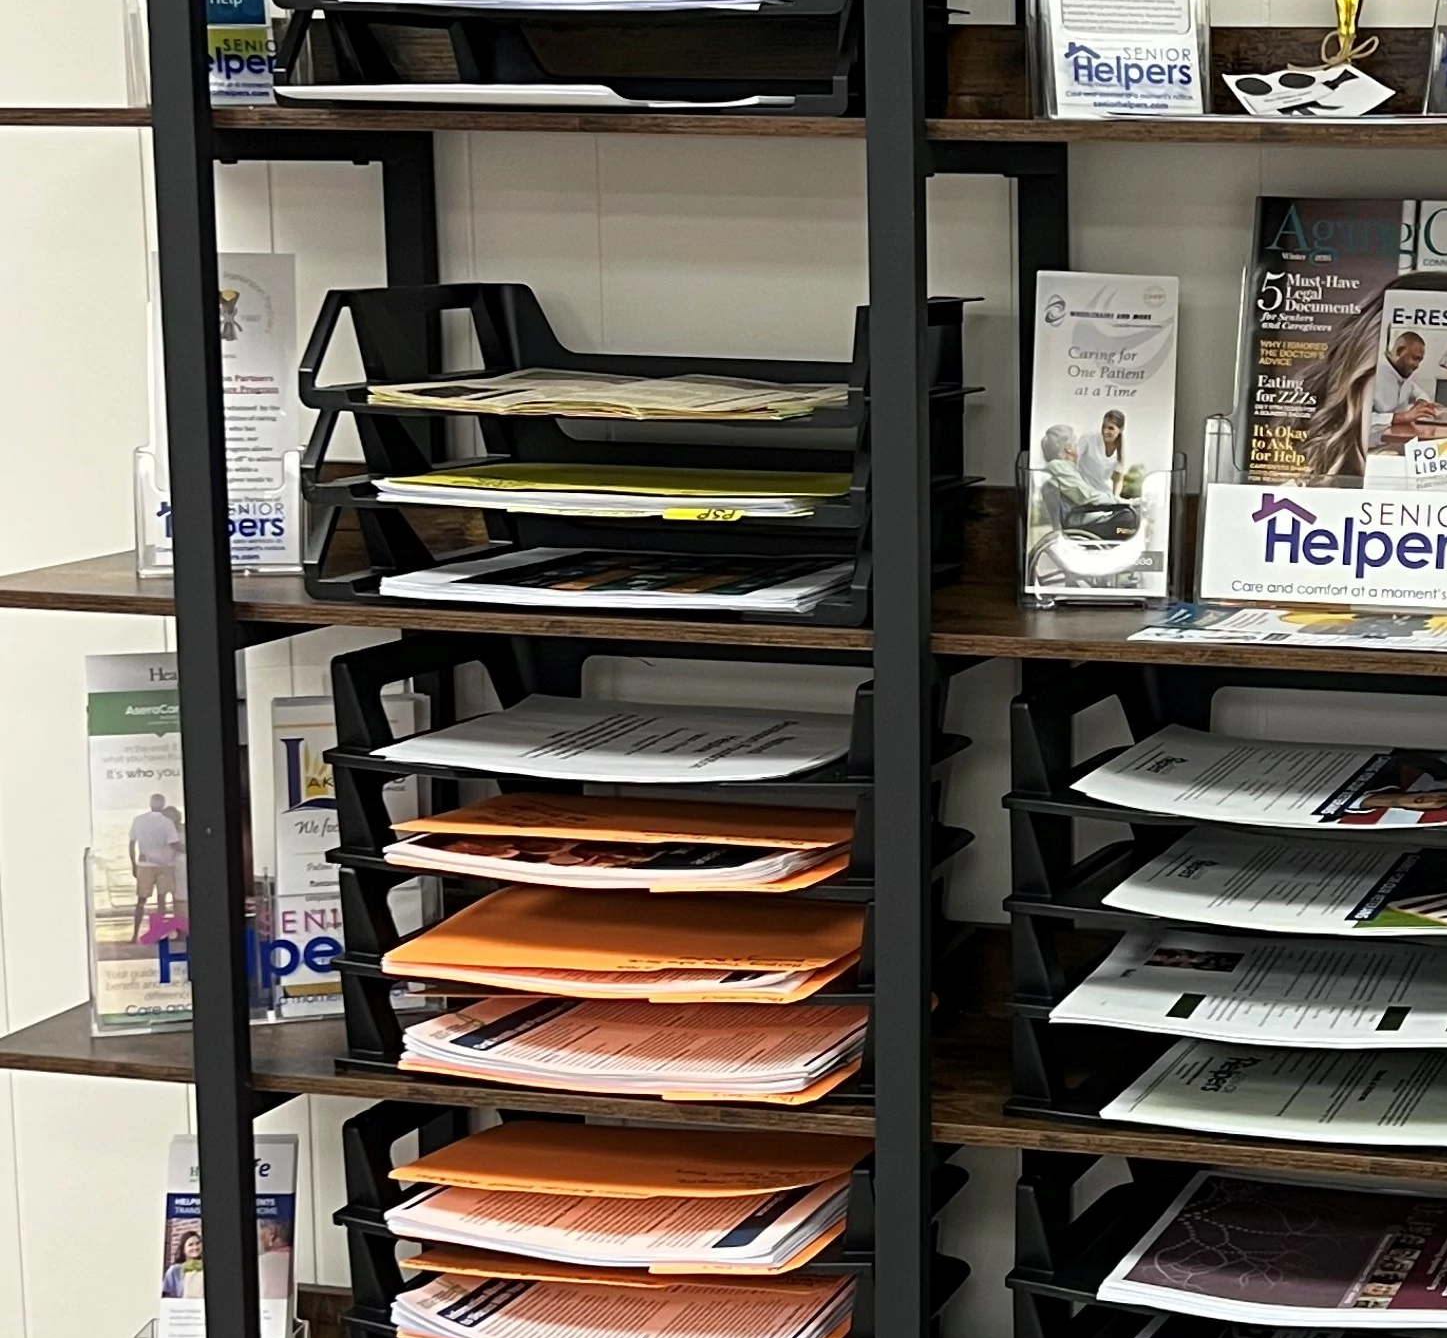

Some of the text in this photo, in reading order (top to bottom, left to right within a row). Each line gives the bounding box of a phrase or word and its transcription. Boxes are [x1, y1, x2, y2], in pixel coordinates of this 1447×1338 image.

[1123, 47, 1191, 61] SENIOR
[1074, 56, 1192, 89] Helpers
[1257, 272, 1360, 310] 5 Must-Have
[1286, 287, 1322, 302] Legal
[1285, 300, 1361, 314] Documents
[1260, 312, 1276, 322] for
[1282, 322, 1331, 332] Caregivers
[1068, 347, 1137, 362] Caring for
[1067, 366, 1145, 380] One Patient
[1258, 375, 1304, 392] Eating
[1075, 386, 1136, 397] at a Time
[1256, 389, 1277, 402] for
[1254, 424, 1308, 441] It's Okay
[1252, 438, 1293, 450] to Ask
[1251, 449, 1305, 465] for Help
[1232, 580, 1263, 593] Care
[1267, 582, 1293, 594] and
[1297, 583, 1348, 595] comfort
[1351, 585, 1365, 596] at
[1368, 588, 1377, 596] a
[1381, 587, 1447, 600] moment's
[126, 768, 180, 780] who you
